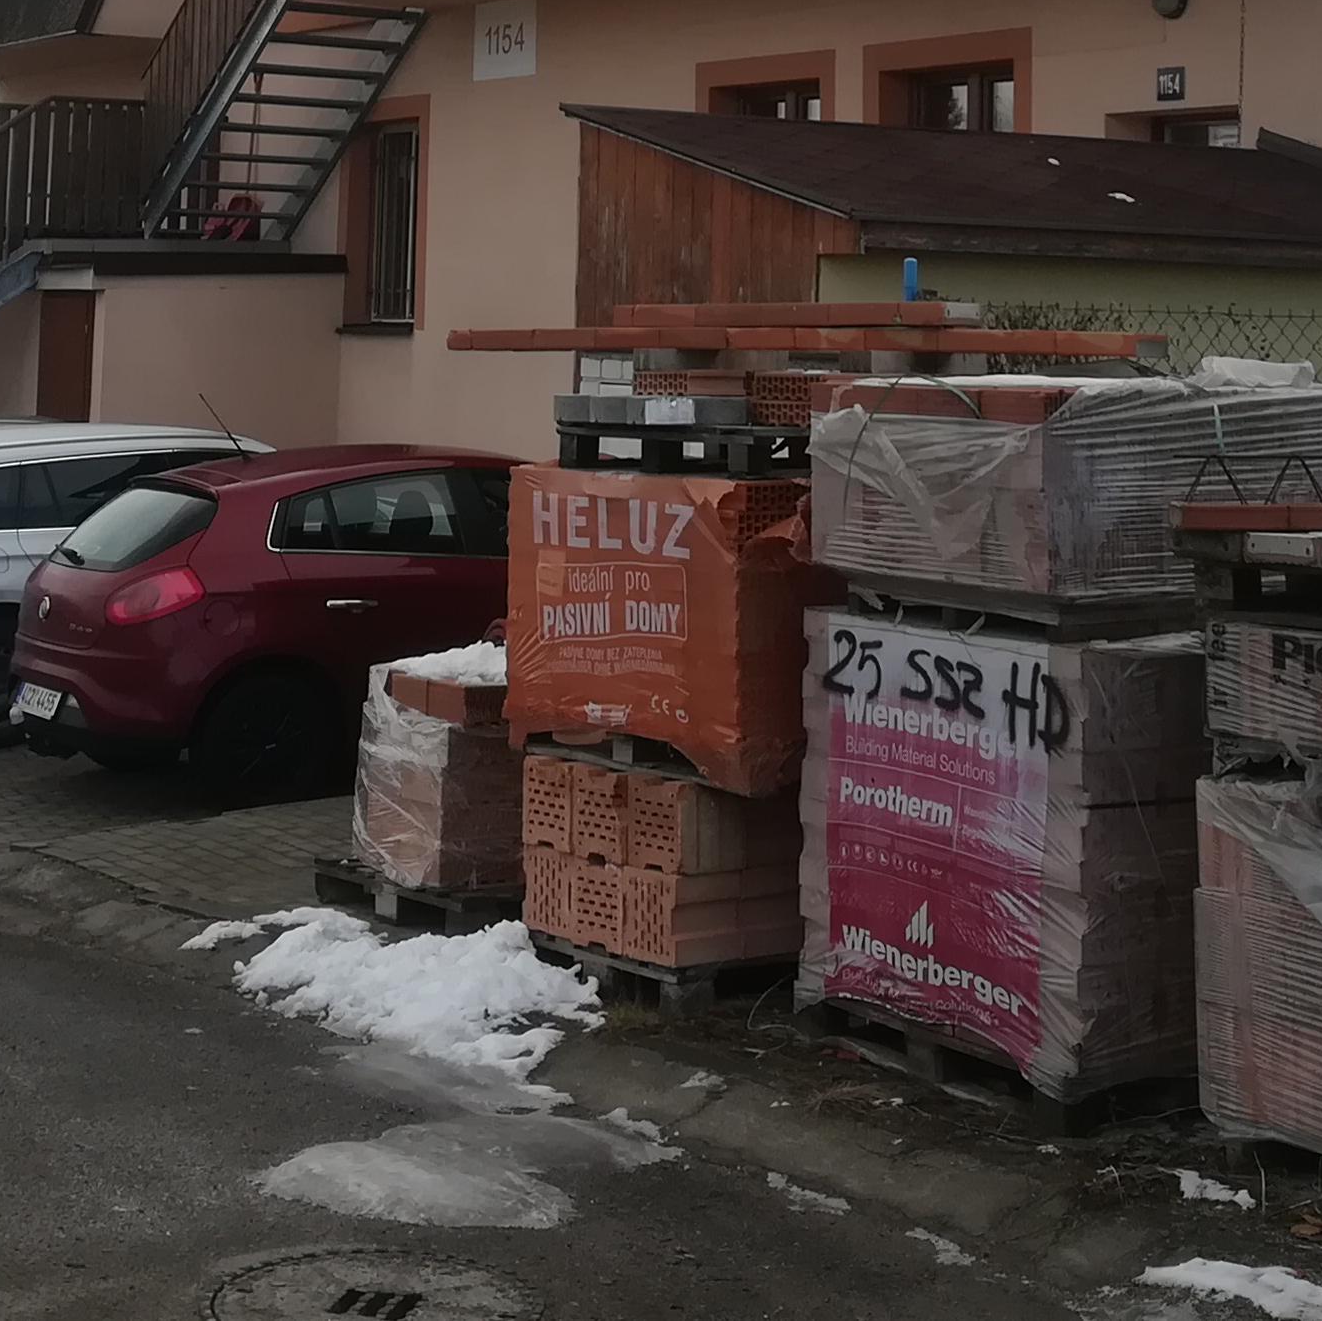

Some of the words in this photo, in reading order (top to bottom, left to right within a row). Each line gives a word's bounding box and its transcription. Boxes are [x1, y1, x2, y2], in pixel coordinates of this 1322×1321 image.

[485, 22, 525, 56] 1154
[1159, 73, 1180, 95] 1154
[532, 490, 695, 560] HELUZ
[568, 565, 615, 592] ideální
[625, 570, 651, 595] pro
[543, 592, 611, 637] PASIVNÍ
[625, 599, 681, 634] DOMY
[824, 629, 883, 700] 25
[1002, 661, 1070, 752] HD
[845, 735, 889, 763] Building
[891, 742, 937, 770] Material
[939, 754, 996, 786] Solutions
[839, 776, 954, 828] Porotherm
[841, 923, 1025, 1018] Wienerberger
